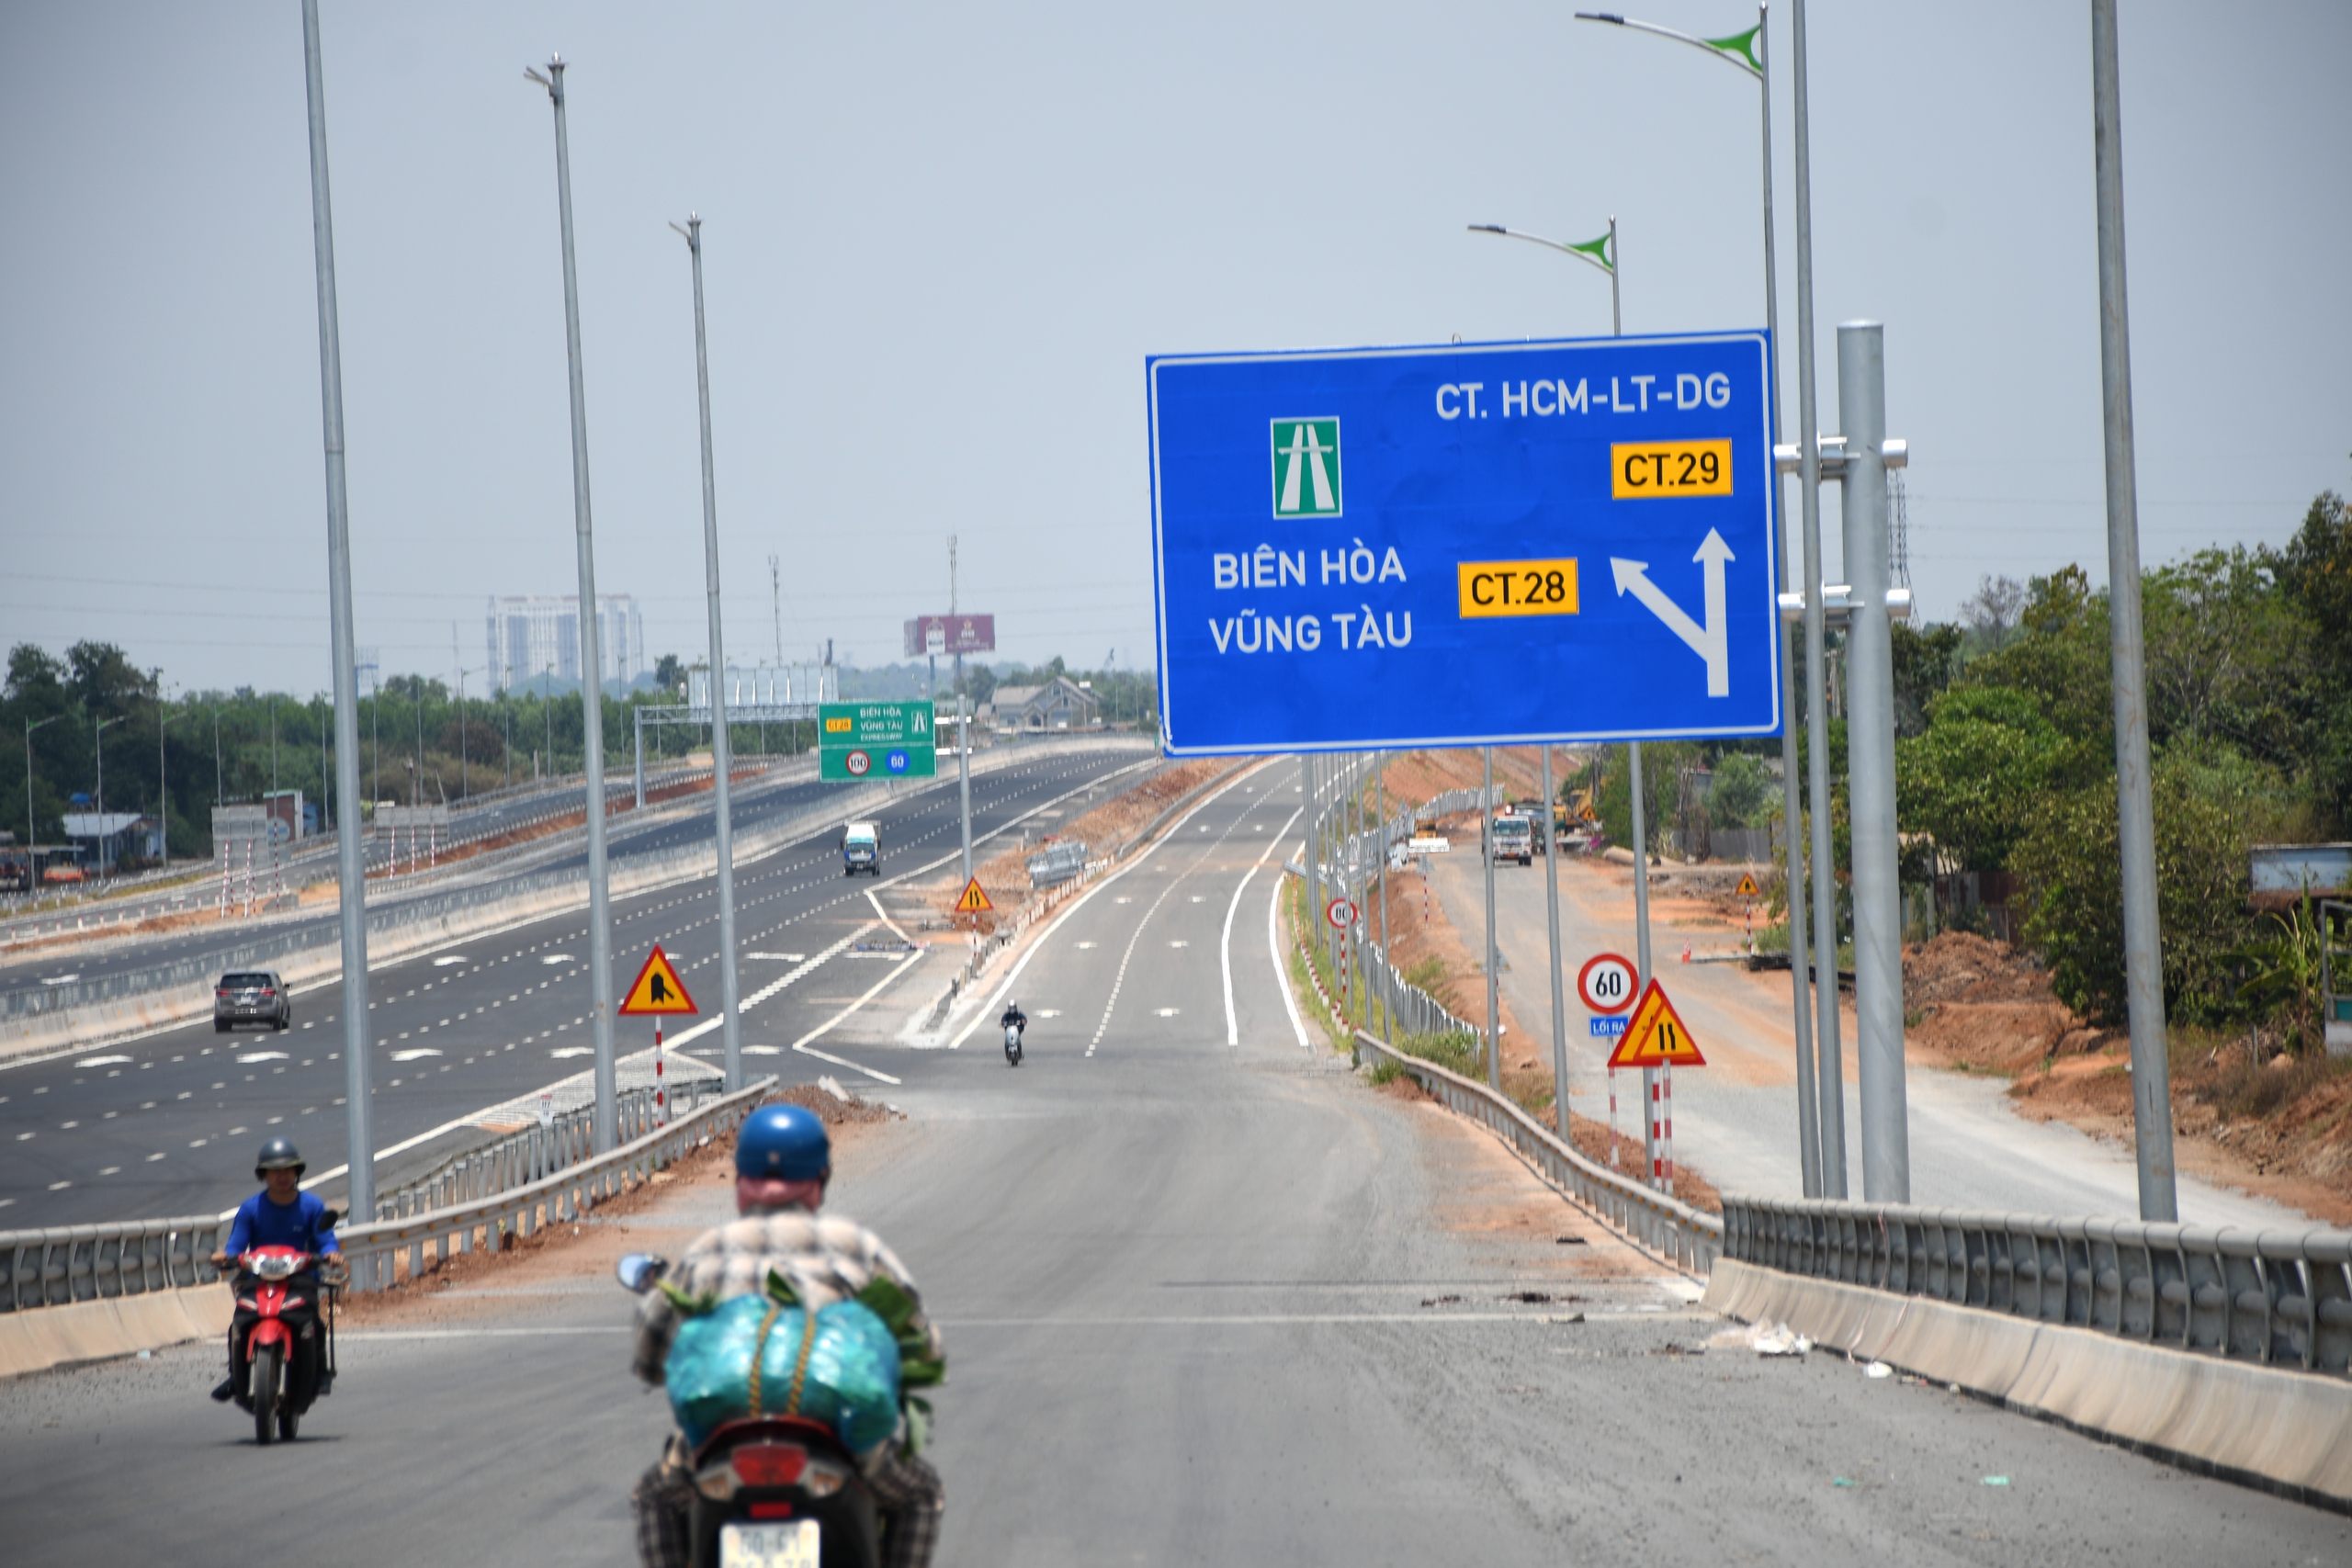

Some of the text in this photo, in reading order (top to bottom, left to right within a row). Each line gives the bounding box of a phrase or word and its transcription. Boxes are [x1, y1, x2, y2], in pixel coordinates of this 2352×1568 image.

[1436, 371, 1731, 421] CT. HCM-LT-DG
[1624, 451, 1720, 487] CT.29
[1214, 536, 1407, 590] BIÊN HÒA
[1472, 570, 1566, 606] CT.28
[1208, 604, 1412, 654] VŨNG TÀU
[860, 705, 902, 719] BIÊN HÒA
[860, 718, 903, 732] VŨNG TÀU
[860, 732, 903, 743] EXPRESSWAY
[850, 757, 866, 770] 100
[1595, 970, 1622, 998] 60
[1592, 1018, 1626, 1034] LỐI RA
